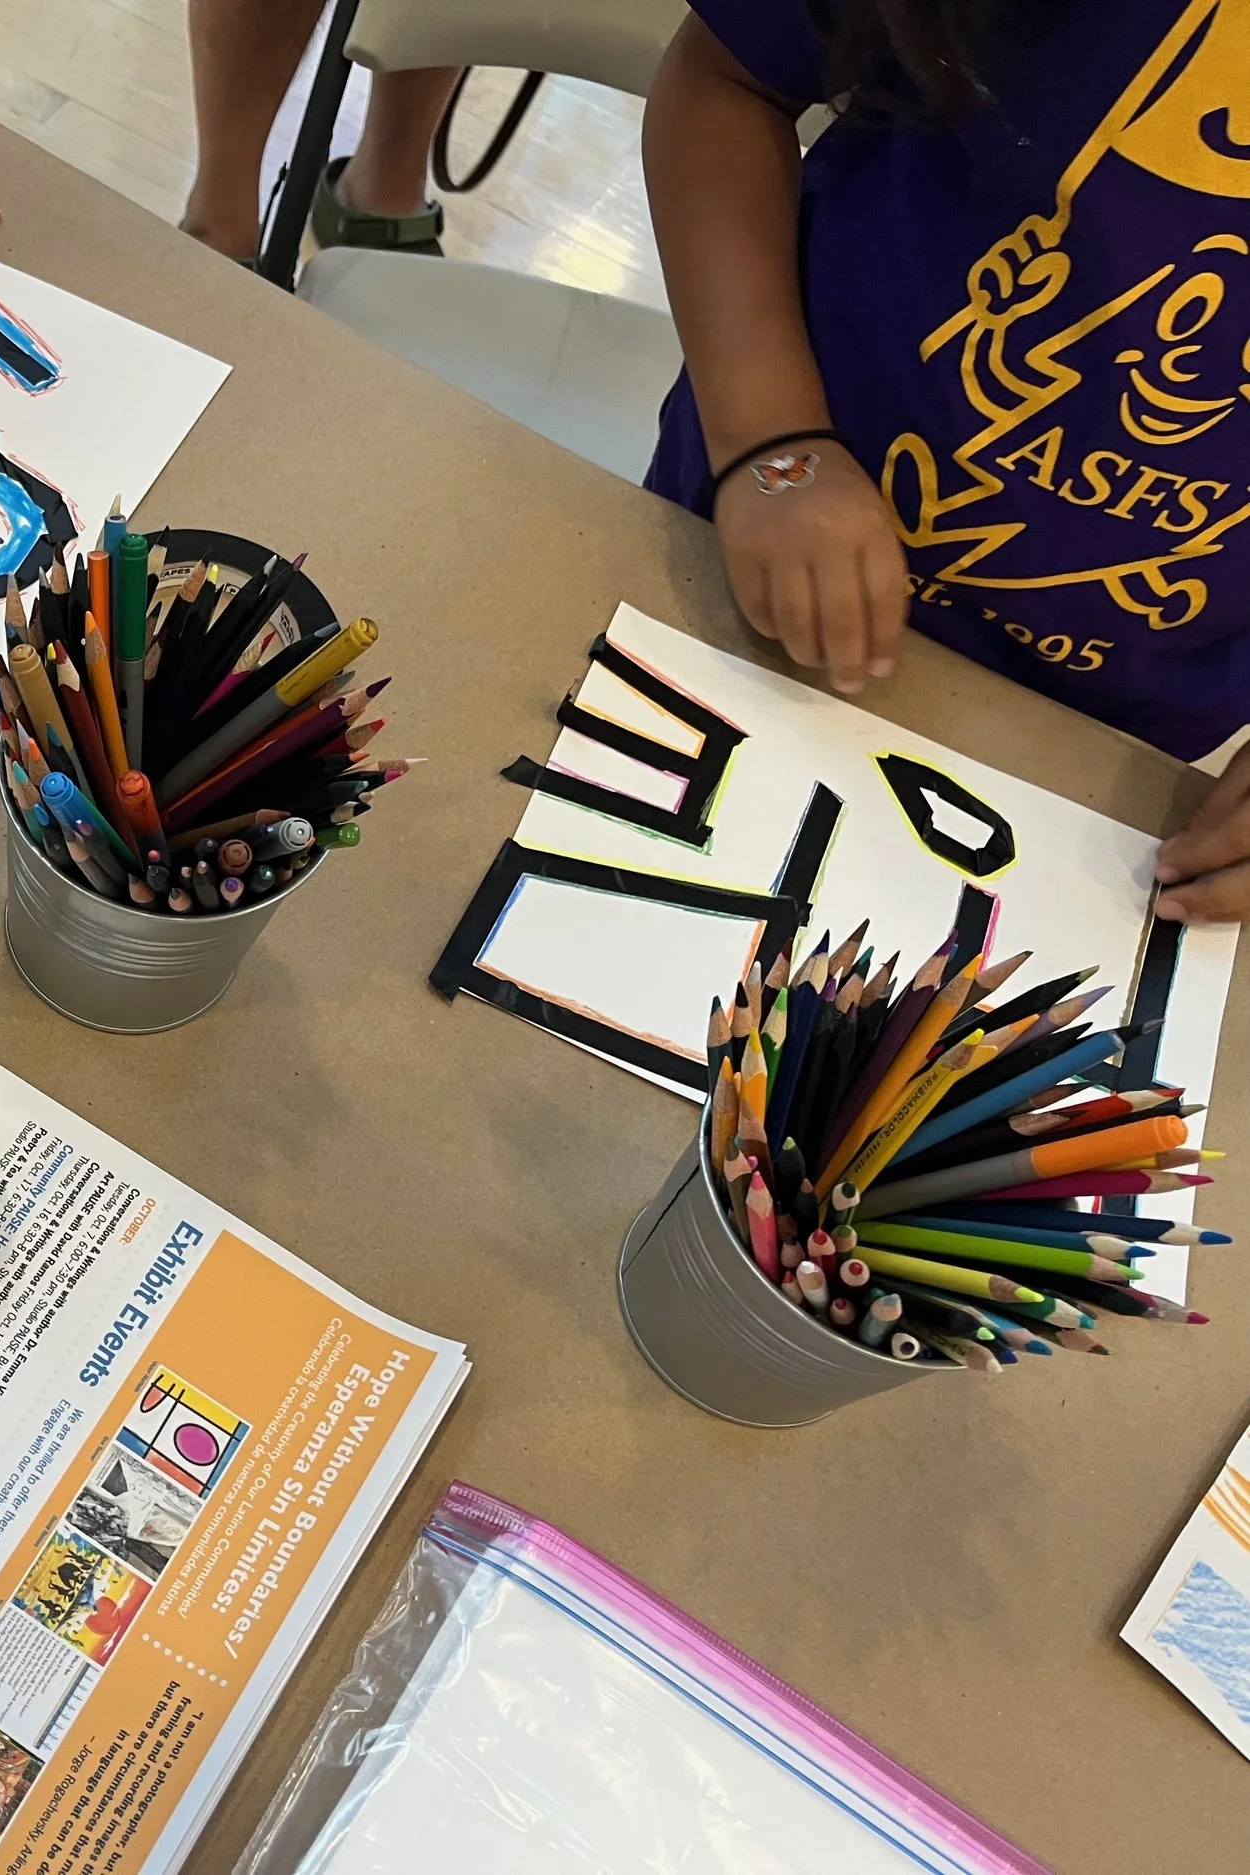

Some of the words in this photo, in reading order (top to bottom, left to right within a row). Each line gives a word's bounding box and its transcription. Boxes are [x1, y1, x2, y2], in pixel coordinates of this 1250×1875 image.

[996, 426, 1230, 534] ASFS
[904, 573, 953, 608] st.
[58, 1152, 90, 1191] Thursday,
[98, 1169, 114, 1186] Art
[46, 1189, 64, 1208] Oct.
[79, 1184, 105, 1215] PAUSE
[99, 1181, 130, 1213] Tuesday,
[35, 1207, 52, 1223] 16,
[67, 1213, 84, 1232] with
[89, 1213, 106, 1230] Oct.
[95, 1187, 140, 1246] Conversations
[117, 1197, 156, 1246] OCTOBER:
[15, 1220, 42, 1252] 6:30–8
[49, 1231, 73, 1258] David
[81, 1230, 95, 1240] 7,
[88, 1245, 100, 1255] &
[3, 1249, 22, 1268] pm,
[28, 1255, 55, 1287] Ramos
[65, 1254, 95, 1290] Writings
[132, 1219, 203, 1306] Exhibit
[10, 1286, 35, 1312] Friday
[41, 1280, 58, 1296] pm,
[52, 1289, 69, 1309] with
[24, 1298, 48, 1325] Studio
[32, 1308, 55, 1339] author
[2, 1323, 30, 1355] PAUSE,
[21, 1338, 37, 1352] Dr.
[78, 1302, 149, 1387] Events
[301, 1317, 342, 1375] Celebrando
[0, 1352, 27, 1383] Emma
[307, 1332, 351, 1391] Celebrating
[294, 1374, 308, 1385] la
[363, 1349, 410, 1408] Hope
[298, 1390, 315, 1409] the
[40, 1398, 71, 1434] Engage
[66, 1407, 84, 1424] We
[259, 1386, 298, 1445] creatividad
[291, 1362, 371, 1473] Esperanza
[27, 1434, 45, 1455] with
[55, 1423, 70, 1441] are
[266, 1410, 305, 1463] Creativity
[16, 1454, 31, 1473] our
[33, 1440, 62, 1475] thrilled
[250, 1442, 266, 1458] de
[305, 1415, 375, 1507] Without
[26, 1472, 40, 1485] to
[222, 1457, 255, 1505] nuestras
[259, 1462, 272, 1479] of
[10, 1485, 30, 1511] offer
[246, 1476, 266, 1501] Our
[268, 1476, 303, 1514] Sin
[224, 1499, 253, 1536] Latino
[178, 1505, 227, 1579] comunidades
[176, 1537, 229, 1619] Communities/
[211, 1517, 280, 1613] Límites:
[155, 1578, 186, 1616] latinas
[222, 1510, 317, 1659] Boundaries/
[161, 1679, 180, 1700] but
[144, 1699, 168, 1729] there
[158, 1695, 191, 1739] framing
[115, 1728, 130, 1741] in
[132, 1730, 148, 1750] are
[179, 1720, 195, 1739] am
[69, 1743, 92, 1773] Jorge
[146, 1739, 164, 1764] and
[162, 1760, 172, 1769] a
[167, 1739, 184, 1760] not
[84, 1741, 122, 1793] language
[83, 1751, 136, 1832] circumstances
[112, 1762, 150, 1818] recording
[69, 1794, 90, 1819] that
[55, 1819, 73, 1842] can
[88, 1818, 120, 1862] images
[6, 1843, 33, 1875] Arling
[45, 1842, 62, 1859] be
[68, 1833, 89, 1859] that
[102, 1851, 122, 1872] but
